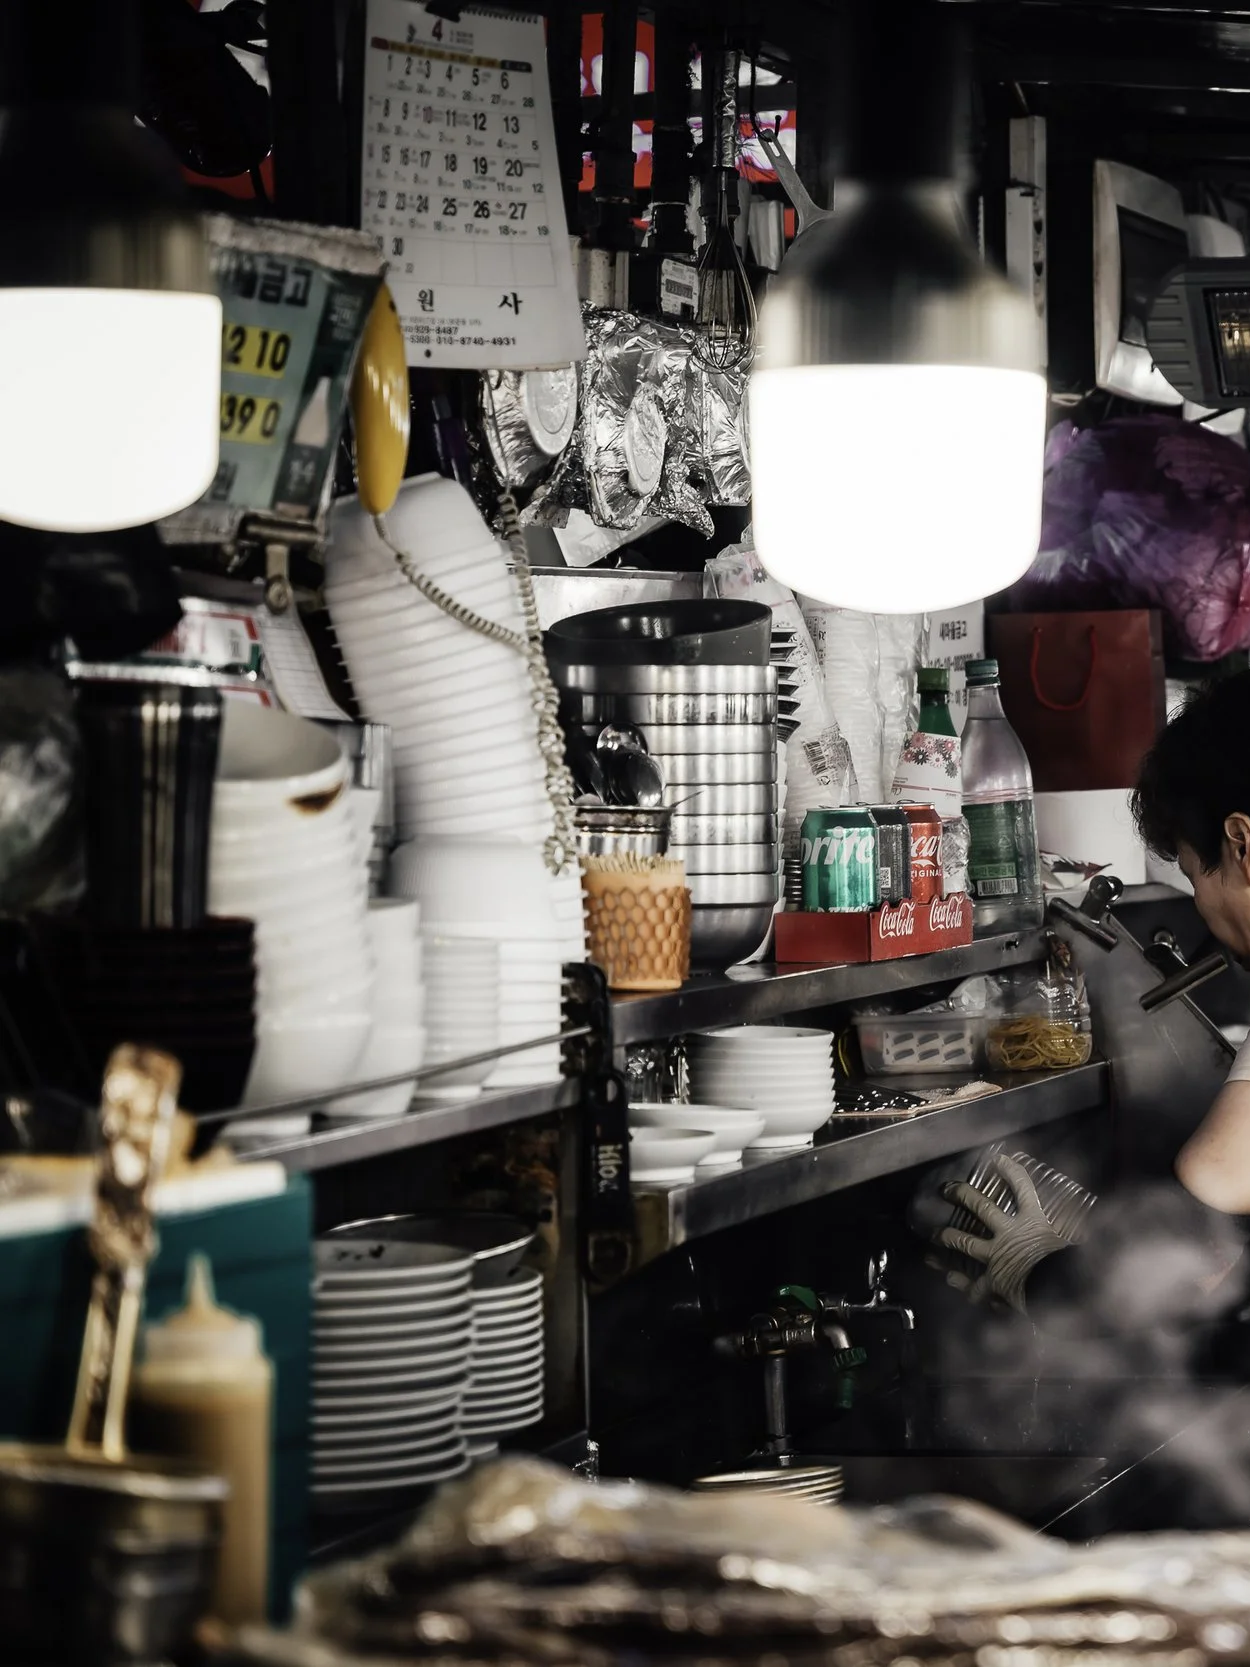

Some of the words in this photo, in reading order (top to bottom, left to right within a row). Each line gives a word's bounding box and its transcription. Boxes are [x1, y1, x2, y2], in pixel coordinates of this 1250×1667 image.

[432, 19, 443, 42] 4
[405, 56, 413, 76] 2
[445, 64, 453, 82] 4
[472, 68, 480, 86] 5
[501, 72, 509, 89] 6
[445, 109, 456, 128] 11
[472, 112, 488, 132] 12
[503, 116, 521, 134] 13
[420, 150, 431, 168] 17
[444, 154, 457, 172] 18
[473, 157, 488, 175] 19
[505, 159, 523, 177] 20
[416, 195, 429, 213] 24
[443, 198, 457, 216] 25
[474, 201, 490, 218] 26
[509, 202, 527, 220] 27
[417, 288, 434, 312] 원
[498, 292, 522, 315] 사
